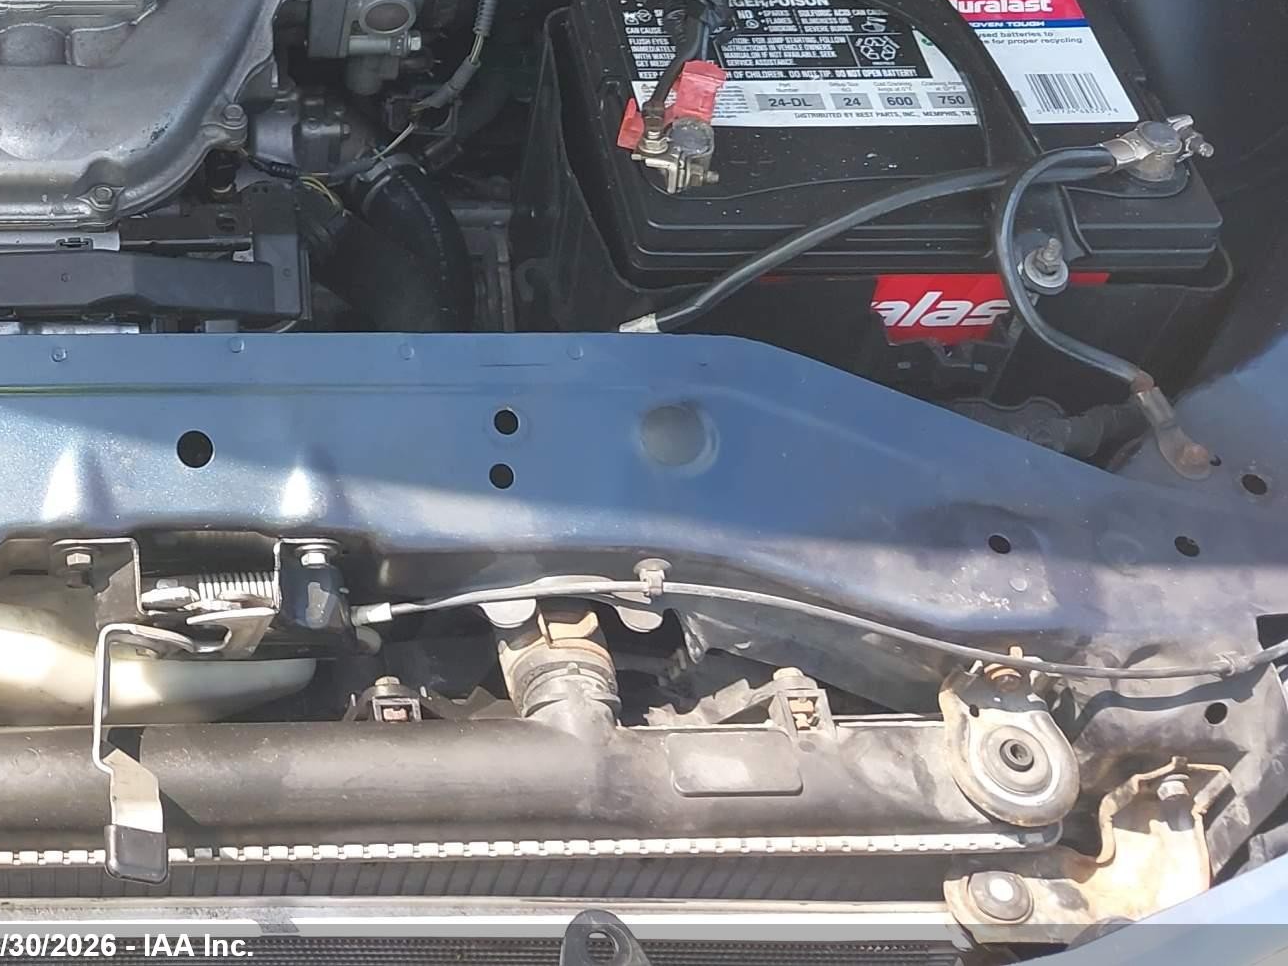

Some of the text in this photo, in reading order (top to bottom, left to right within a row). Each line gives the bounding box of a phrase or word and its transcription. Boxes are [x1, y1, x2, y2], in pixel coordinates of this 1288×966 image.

[736, 10, 753, 19] NO
[1007, 38, 1038, 46] proper
[1040, 37, 1083, 45] recycling
[768, 97, 813, 107] 24-DL
[843, 97, 862, 107] 24
[887, 96, 913, 106] 600
[938, 95, 965, 105] 750
